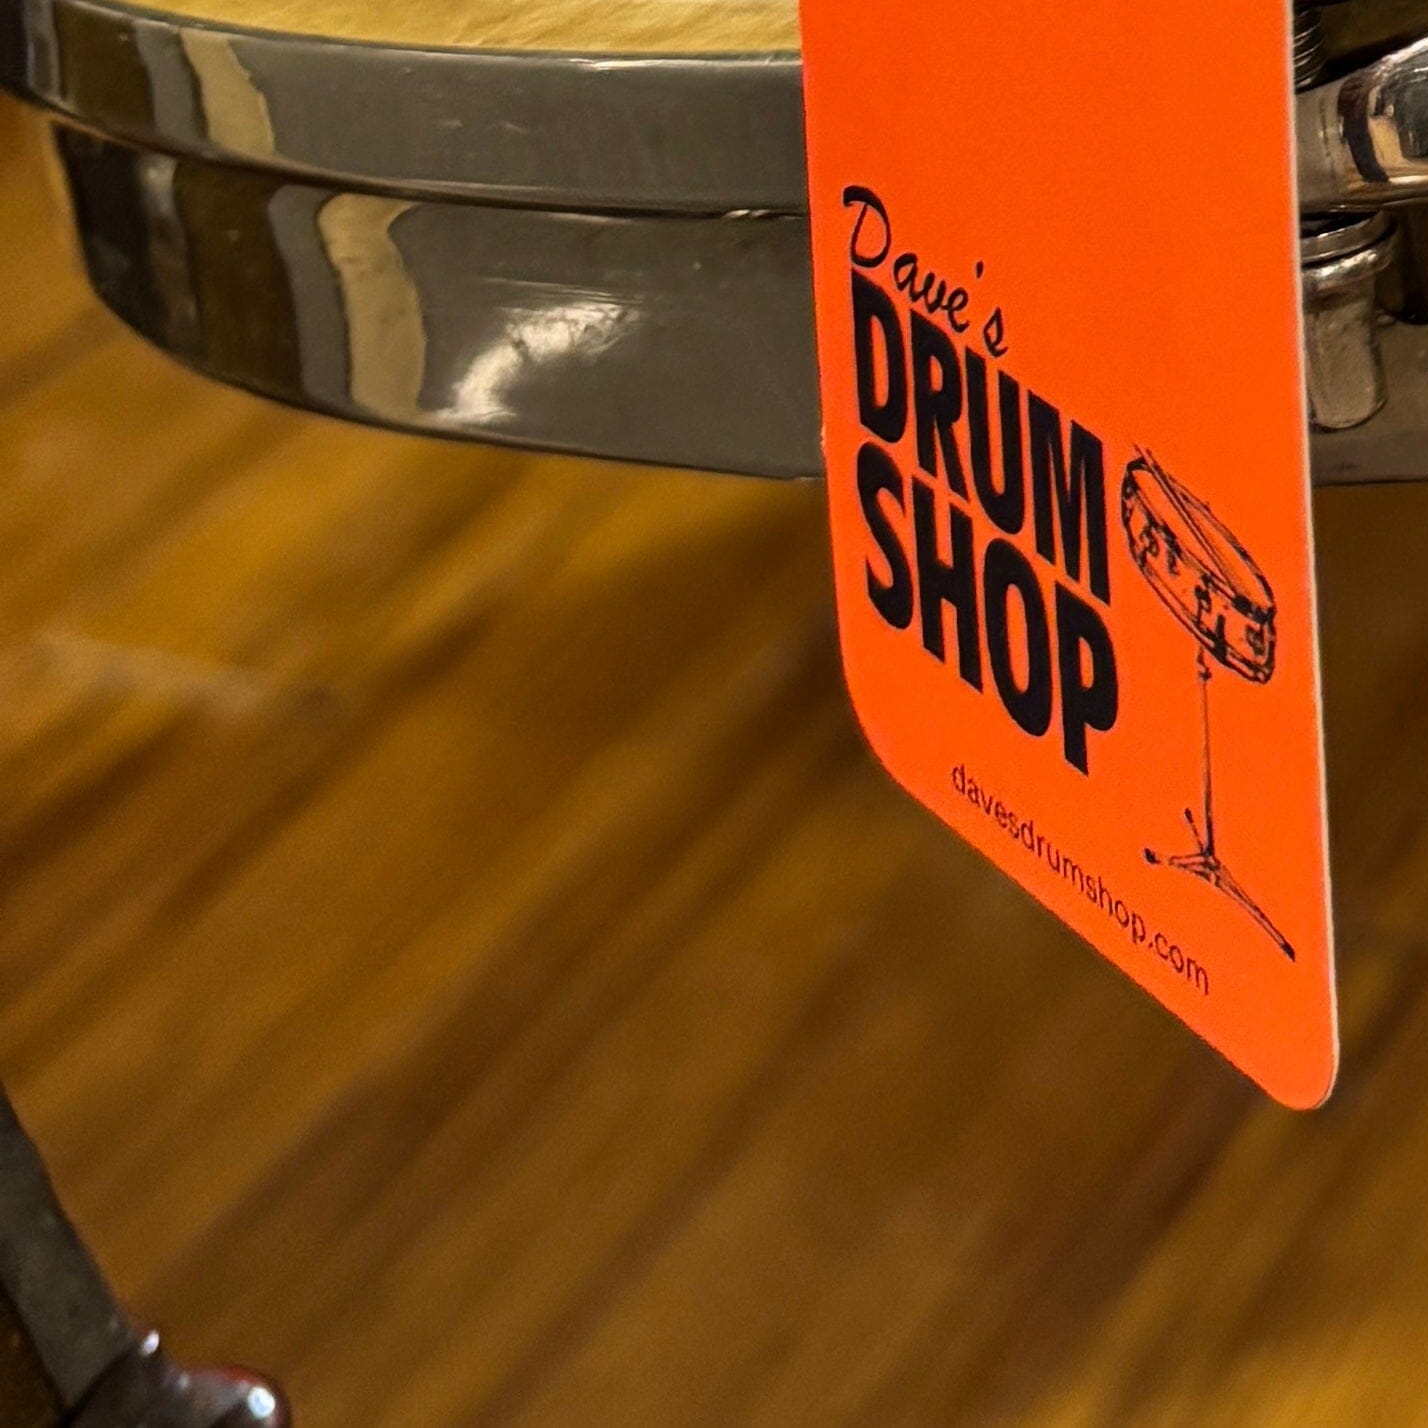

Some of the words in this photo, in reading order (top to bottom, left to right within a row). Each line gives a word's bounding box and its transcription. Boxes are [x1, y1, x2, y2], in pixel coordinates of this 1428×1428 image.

[843, 186, 1009, 357] Dave's
[850, 269, 1112, 606] DRUM
[857, 441, 1120, 776] SHOP
[951, 763, 1211, 995] davesdrumshop.com
